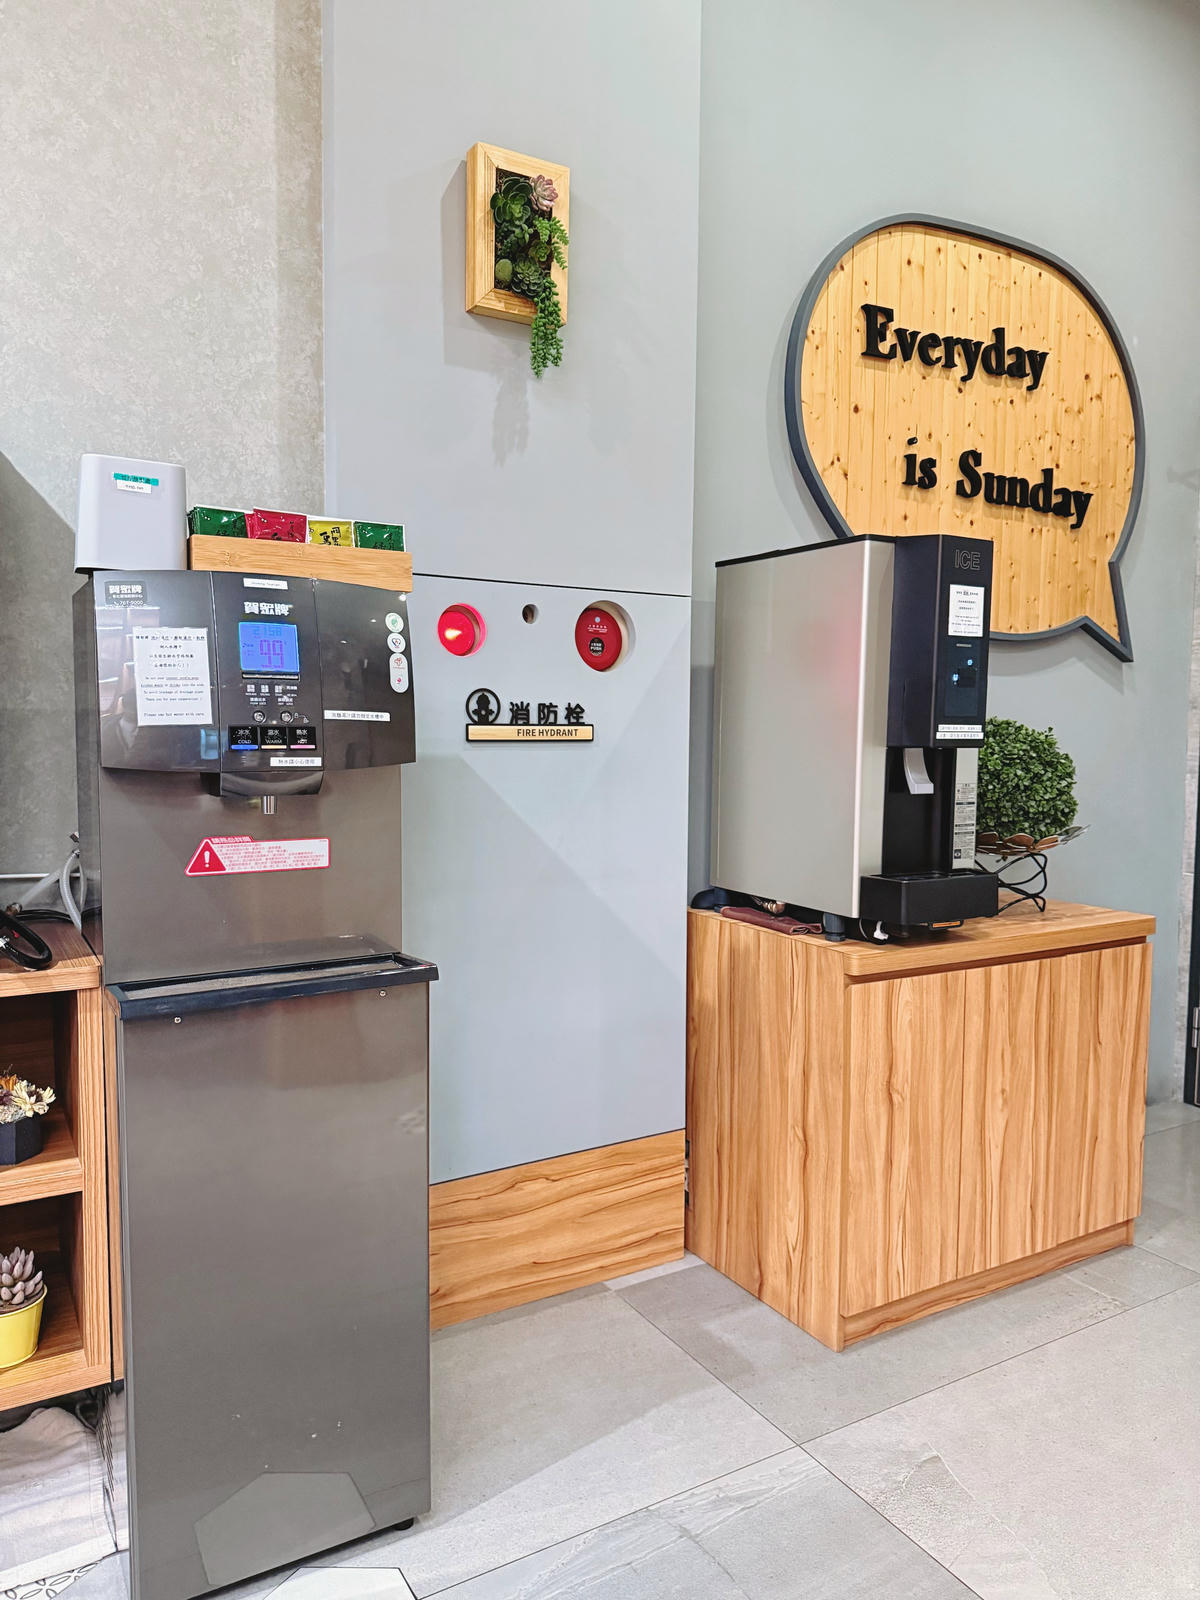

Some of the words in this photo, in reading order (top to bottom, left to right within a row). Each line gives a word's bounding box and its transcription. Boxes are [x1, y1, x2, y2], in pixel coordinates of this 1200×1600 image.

[860, 303, 1049, 391] Everyday
[901, 436, 938, 490] is
[955, 448, 1094, 529] Sunday
[954, 549, 981, 571] ICE
[508, 700, 586, 725] 消防栓
[516, 728, 537, 737] FIRE
[538, 728, 579, 737] HYDRANT
